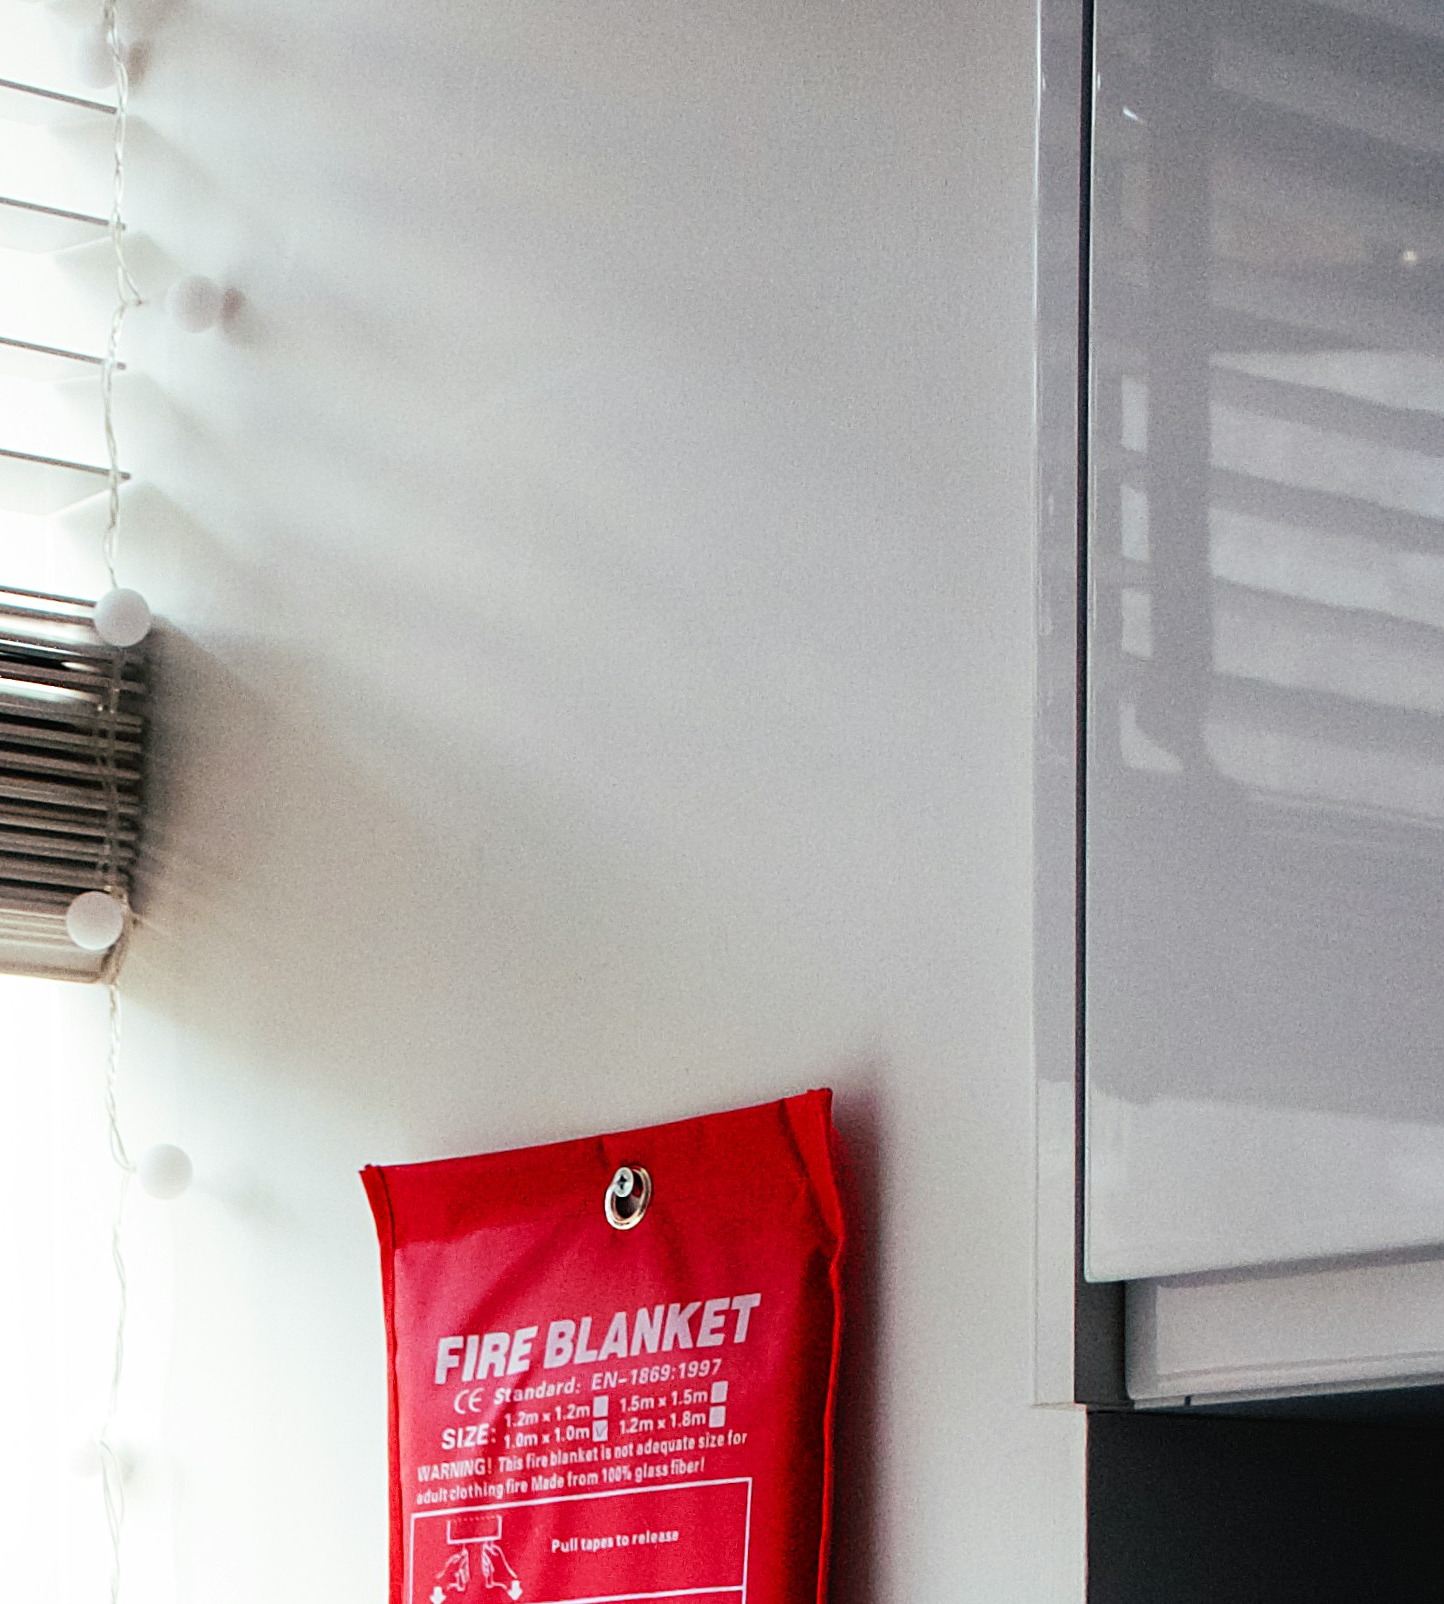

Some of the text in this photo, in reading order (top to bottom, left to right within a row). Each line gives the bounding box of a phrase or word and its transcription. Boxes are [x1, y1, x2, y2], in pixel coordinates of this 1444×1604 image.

[435, 1293, 761, 1384] FIRE BLANKET
[494, 1377, 581, 1405] Standard:
[591, 1358, 722, 1390] EN-1869:1997
[620, 1396, 654, 1412] 1.5m
[671, 1389, 708, 1406] 1.5m
[505, 1411, 538, 1428] 1.2m
[556, 1404, 590, 1421] 1.2m
[620, 1418, 653, 1434] 1.2m
[670, 1411, 706, 1427] 1.8m
[442, 1423, 496, 1450] SIZE:
[504, 1433, 538, 1449] 1.0m
[555, 1425, 590, 1442] 1.0m
[417, 1430, 747, 1482] WARNING! This fire blanket is not adequate size for
[416, 1457, 705, 1505] adult clothing fire Made from 100% glass fiber!
[551, 1530, 679, 1553] Pull tapes to release
